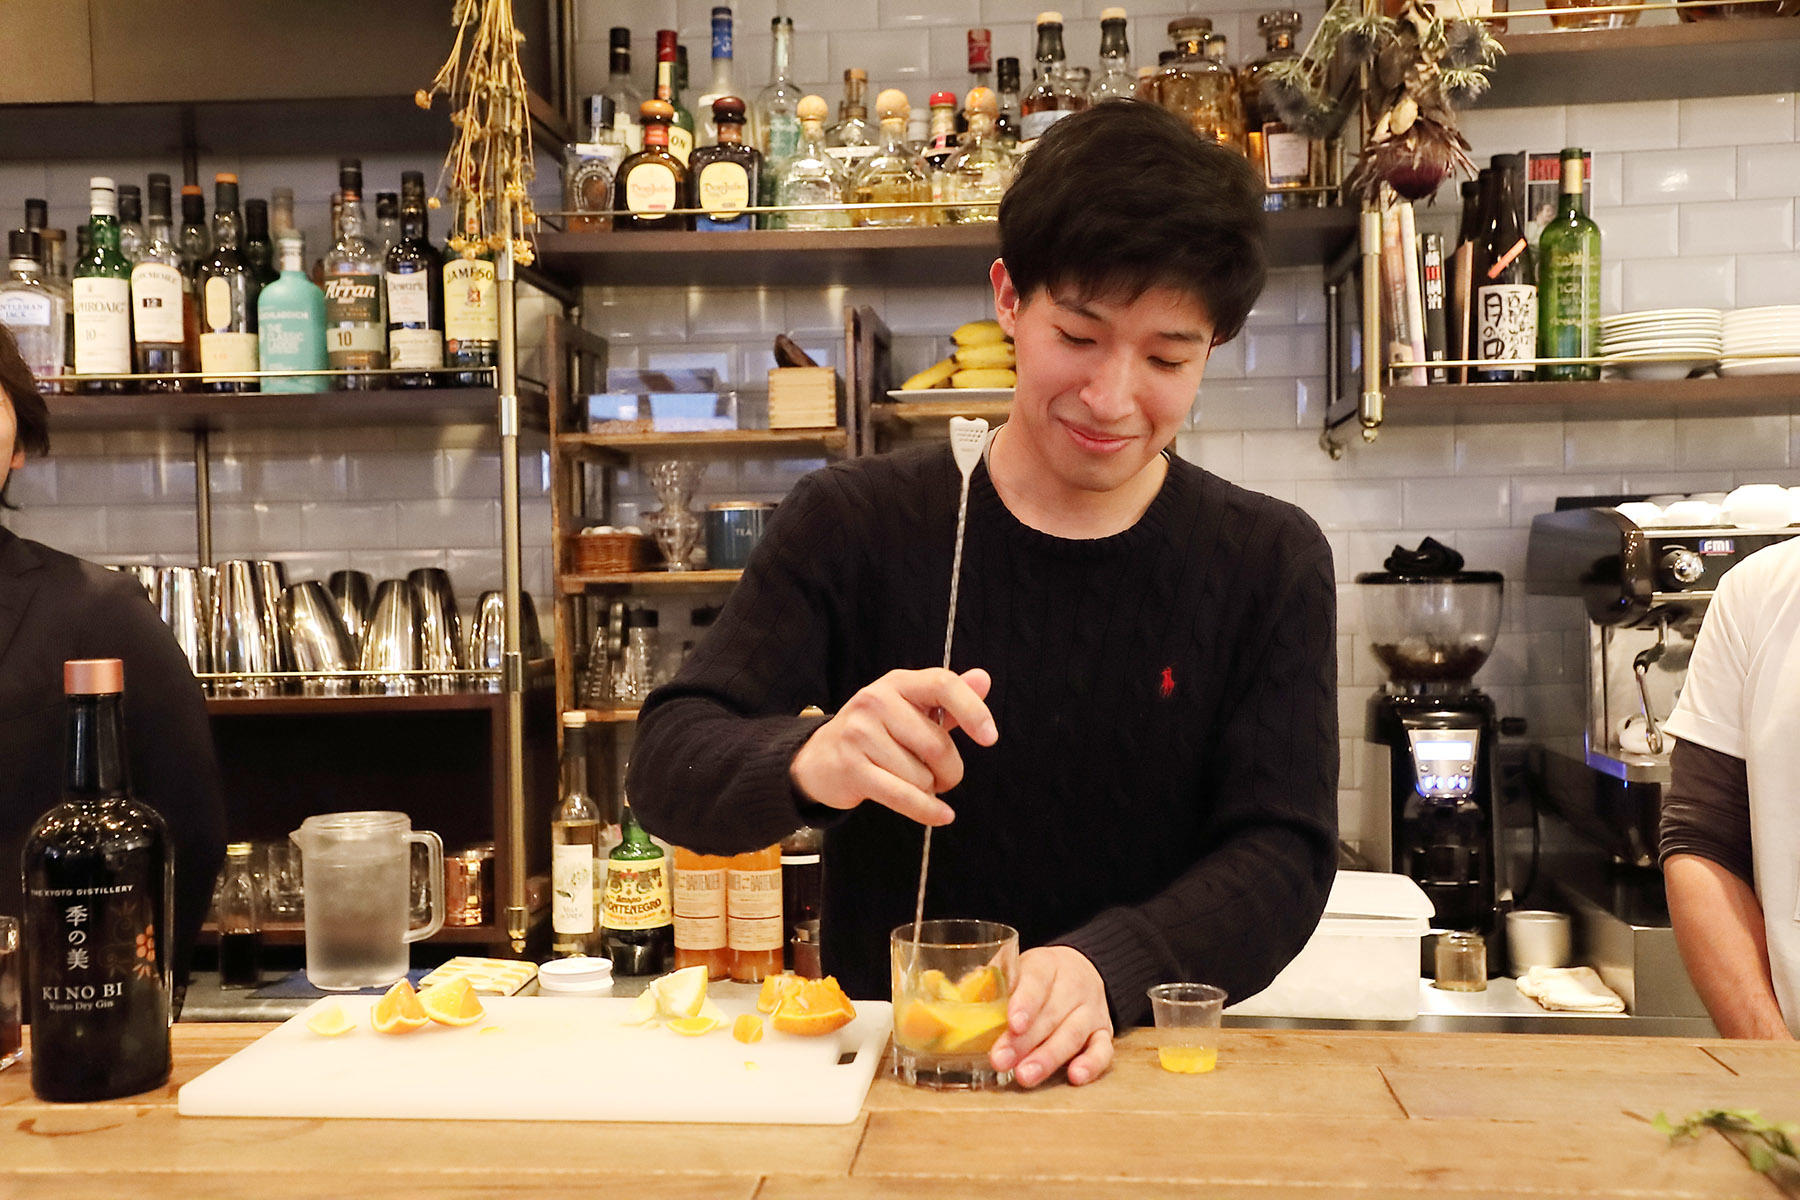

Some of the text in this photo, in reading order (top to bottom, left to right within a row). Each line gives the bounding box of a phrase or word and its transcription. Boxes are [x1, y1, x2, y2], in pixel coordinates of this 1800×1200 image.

[325, 280, 376, 299] Arran
[337, 331, 353, 347] 10
[44, 888, 74, 897] KYOTO
[76, 884, 134, 896] DISTILLERY
[65, 904, 89, 971] 季の美
[42, 982, 123, 1001] KI NO BI
[75, 1001, 94, 1011] Dry
[95, 999, 114, 1010] Gin
